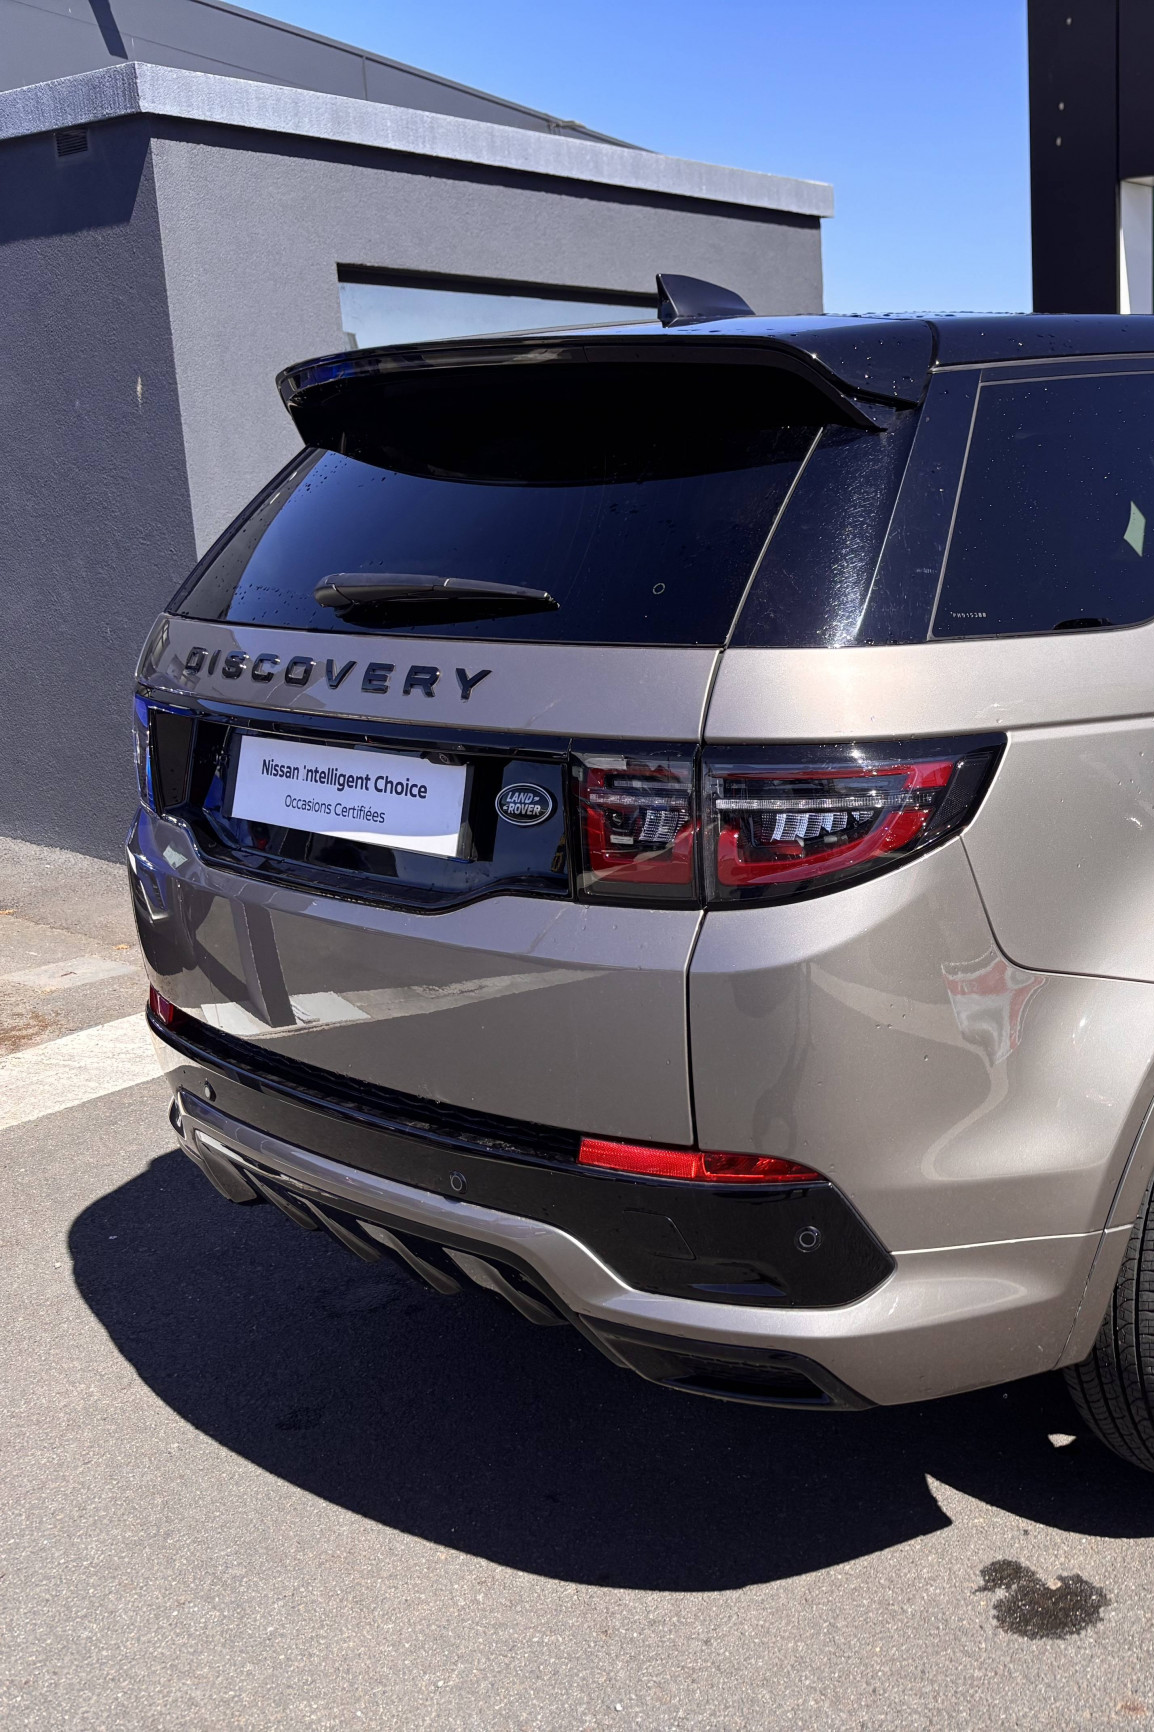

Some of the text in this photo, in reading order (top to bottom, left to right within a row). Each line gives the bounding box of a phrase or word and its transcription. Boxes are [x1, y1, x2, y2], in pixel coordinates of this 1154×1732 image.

[183, 646, 492, 700] DISCOVERY
[261, 759, 300, 781] Nissan
[374, 775, 428, 799] Choice
[284, 794, 385, 824] Occasions Certifiées
[507, 791, 534, 803] LAND
[508, 803, 541, 816] ROVER
